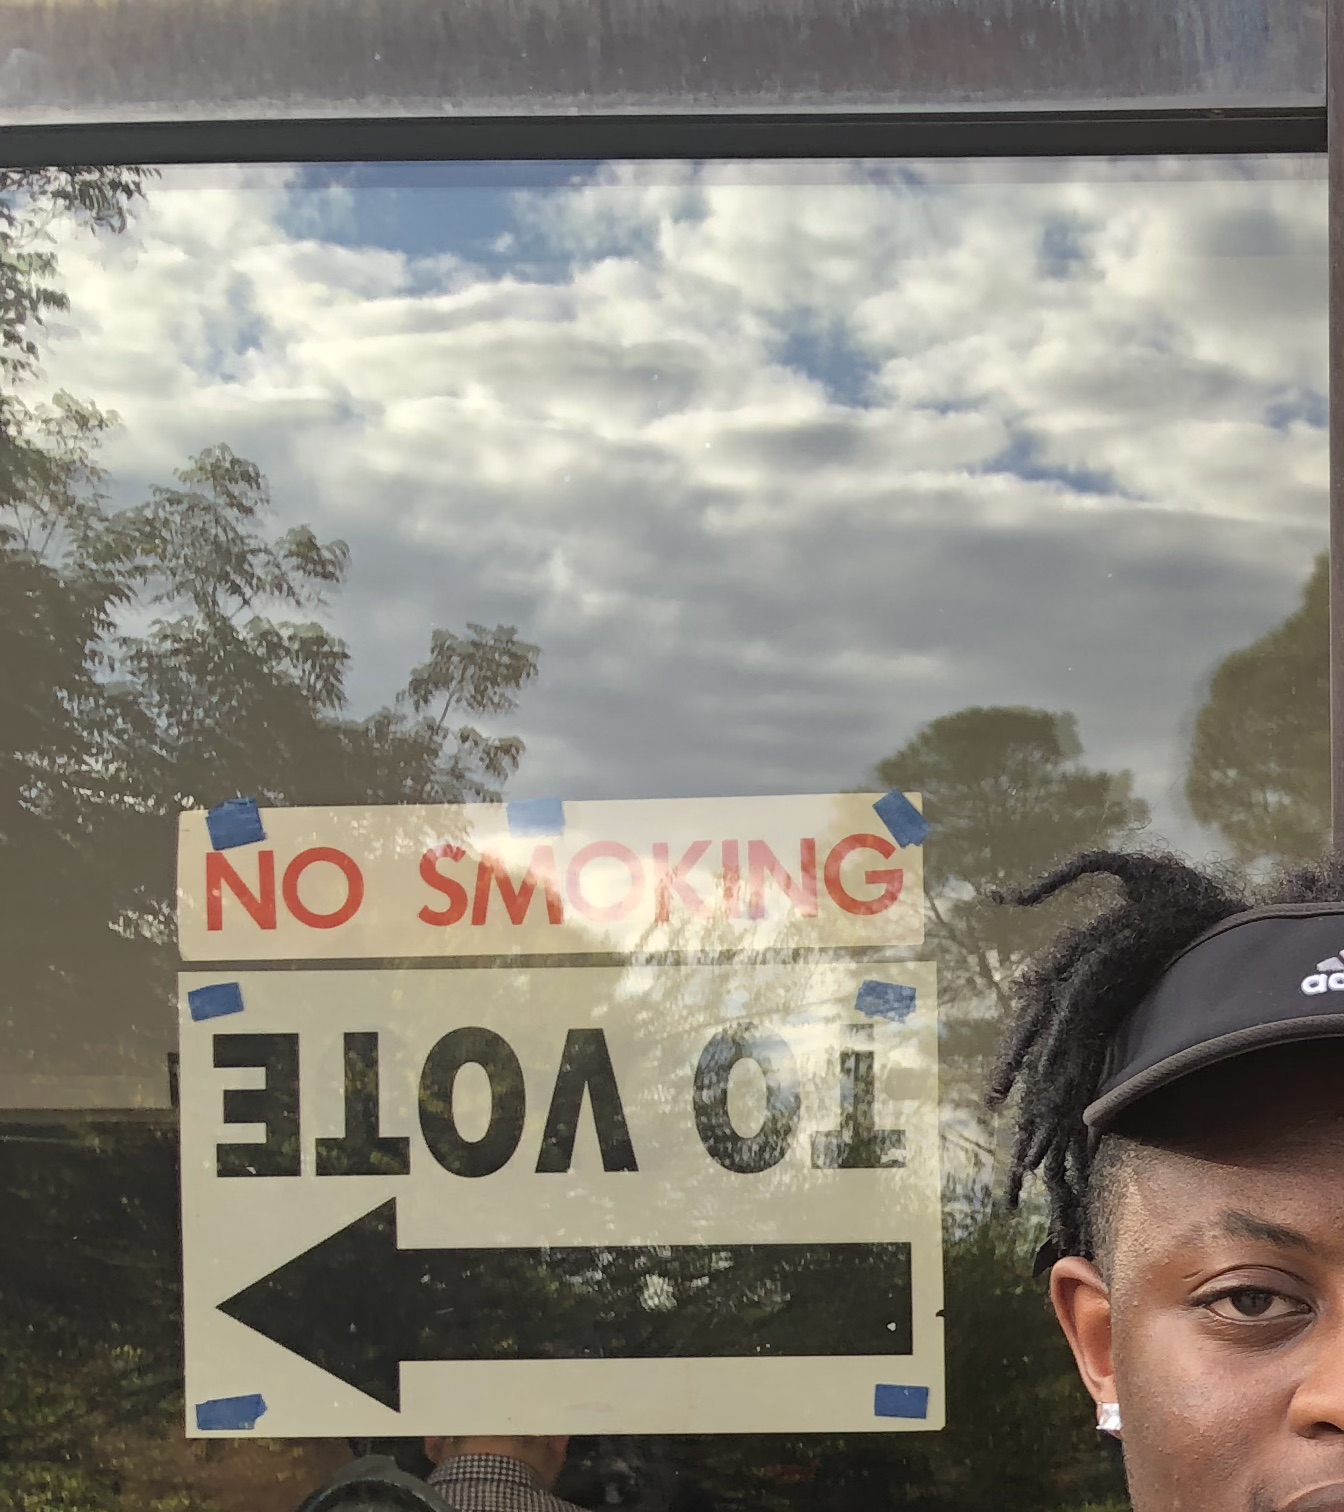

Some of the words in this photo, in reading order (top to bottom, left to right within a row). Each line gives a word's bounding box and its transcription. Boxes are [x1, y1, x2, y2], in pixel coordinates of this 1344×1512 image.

[205, 846, 365, 932] NO
[418, 833, 905, 927] SMOKING
[212, 1025, 640, 1178] VOTE
[692, 1022, 908, 1175] TO
